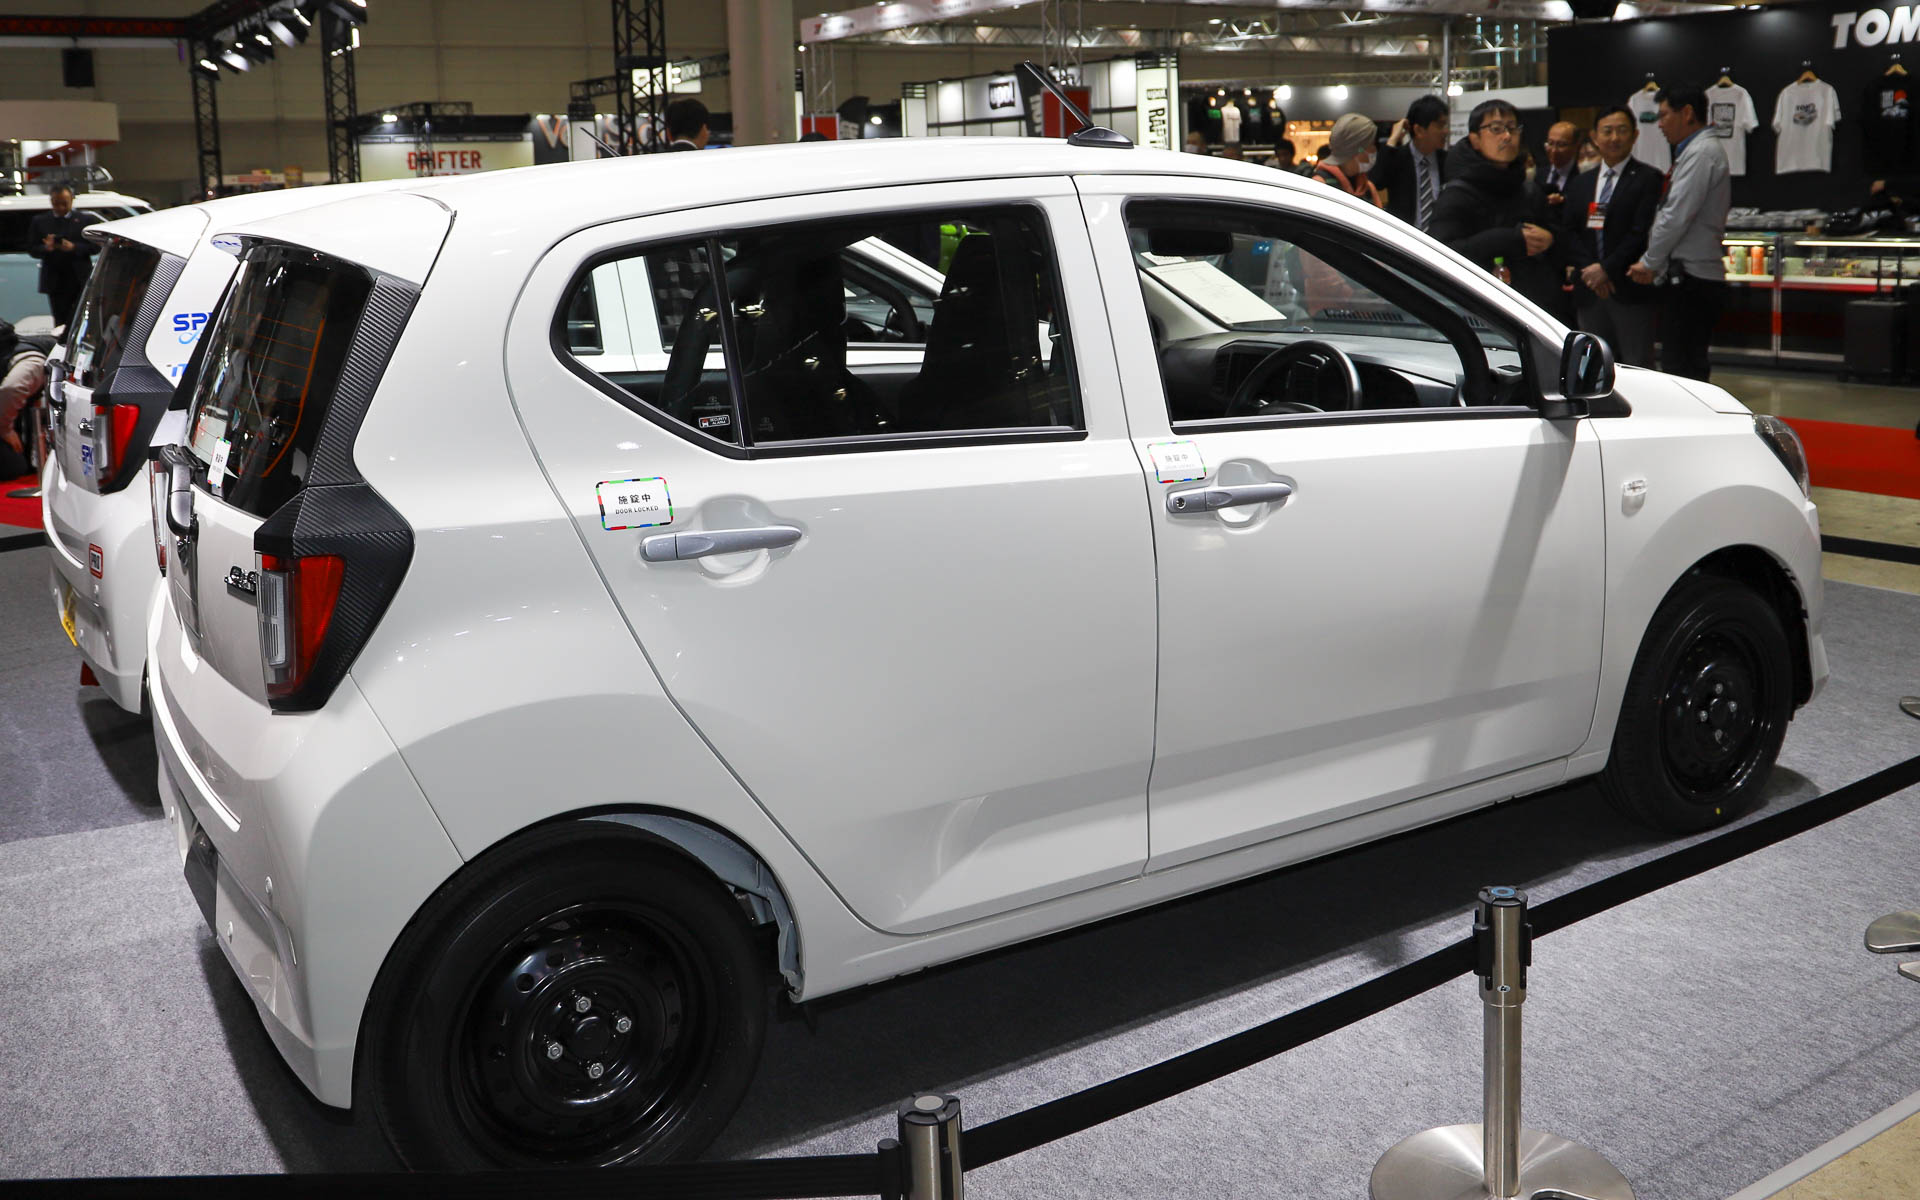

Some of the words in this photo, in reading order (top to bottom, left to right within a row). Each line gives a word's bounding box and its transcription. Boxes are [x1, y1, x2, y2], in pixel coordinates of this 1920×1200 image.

[407, 150, 482, 170] DRIFTER
[173, 312, 213, 331] SP
[618, 494, 651, 504] 施錠中
